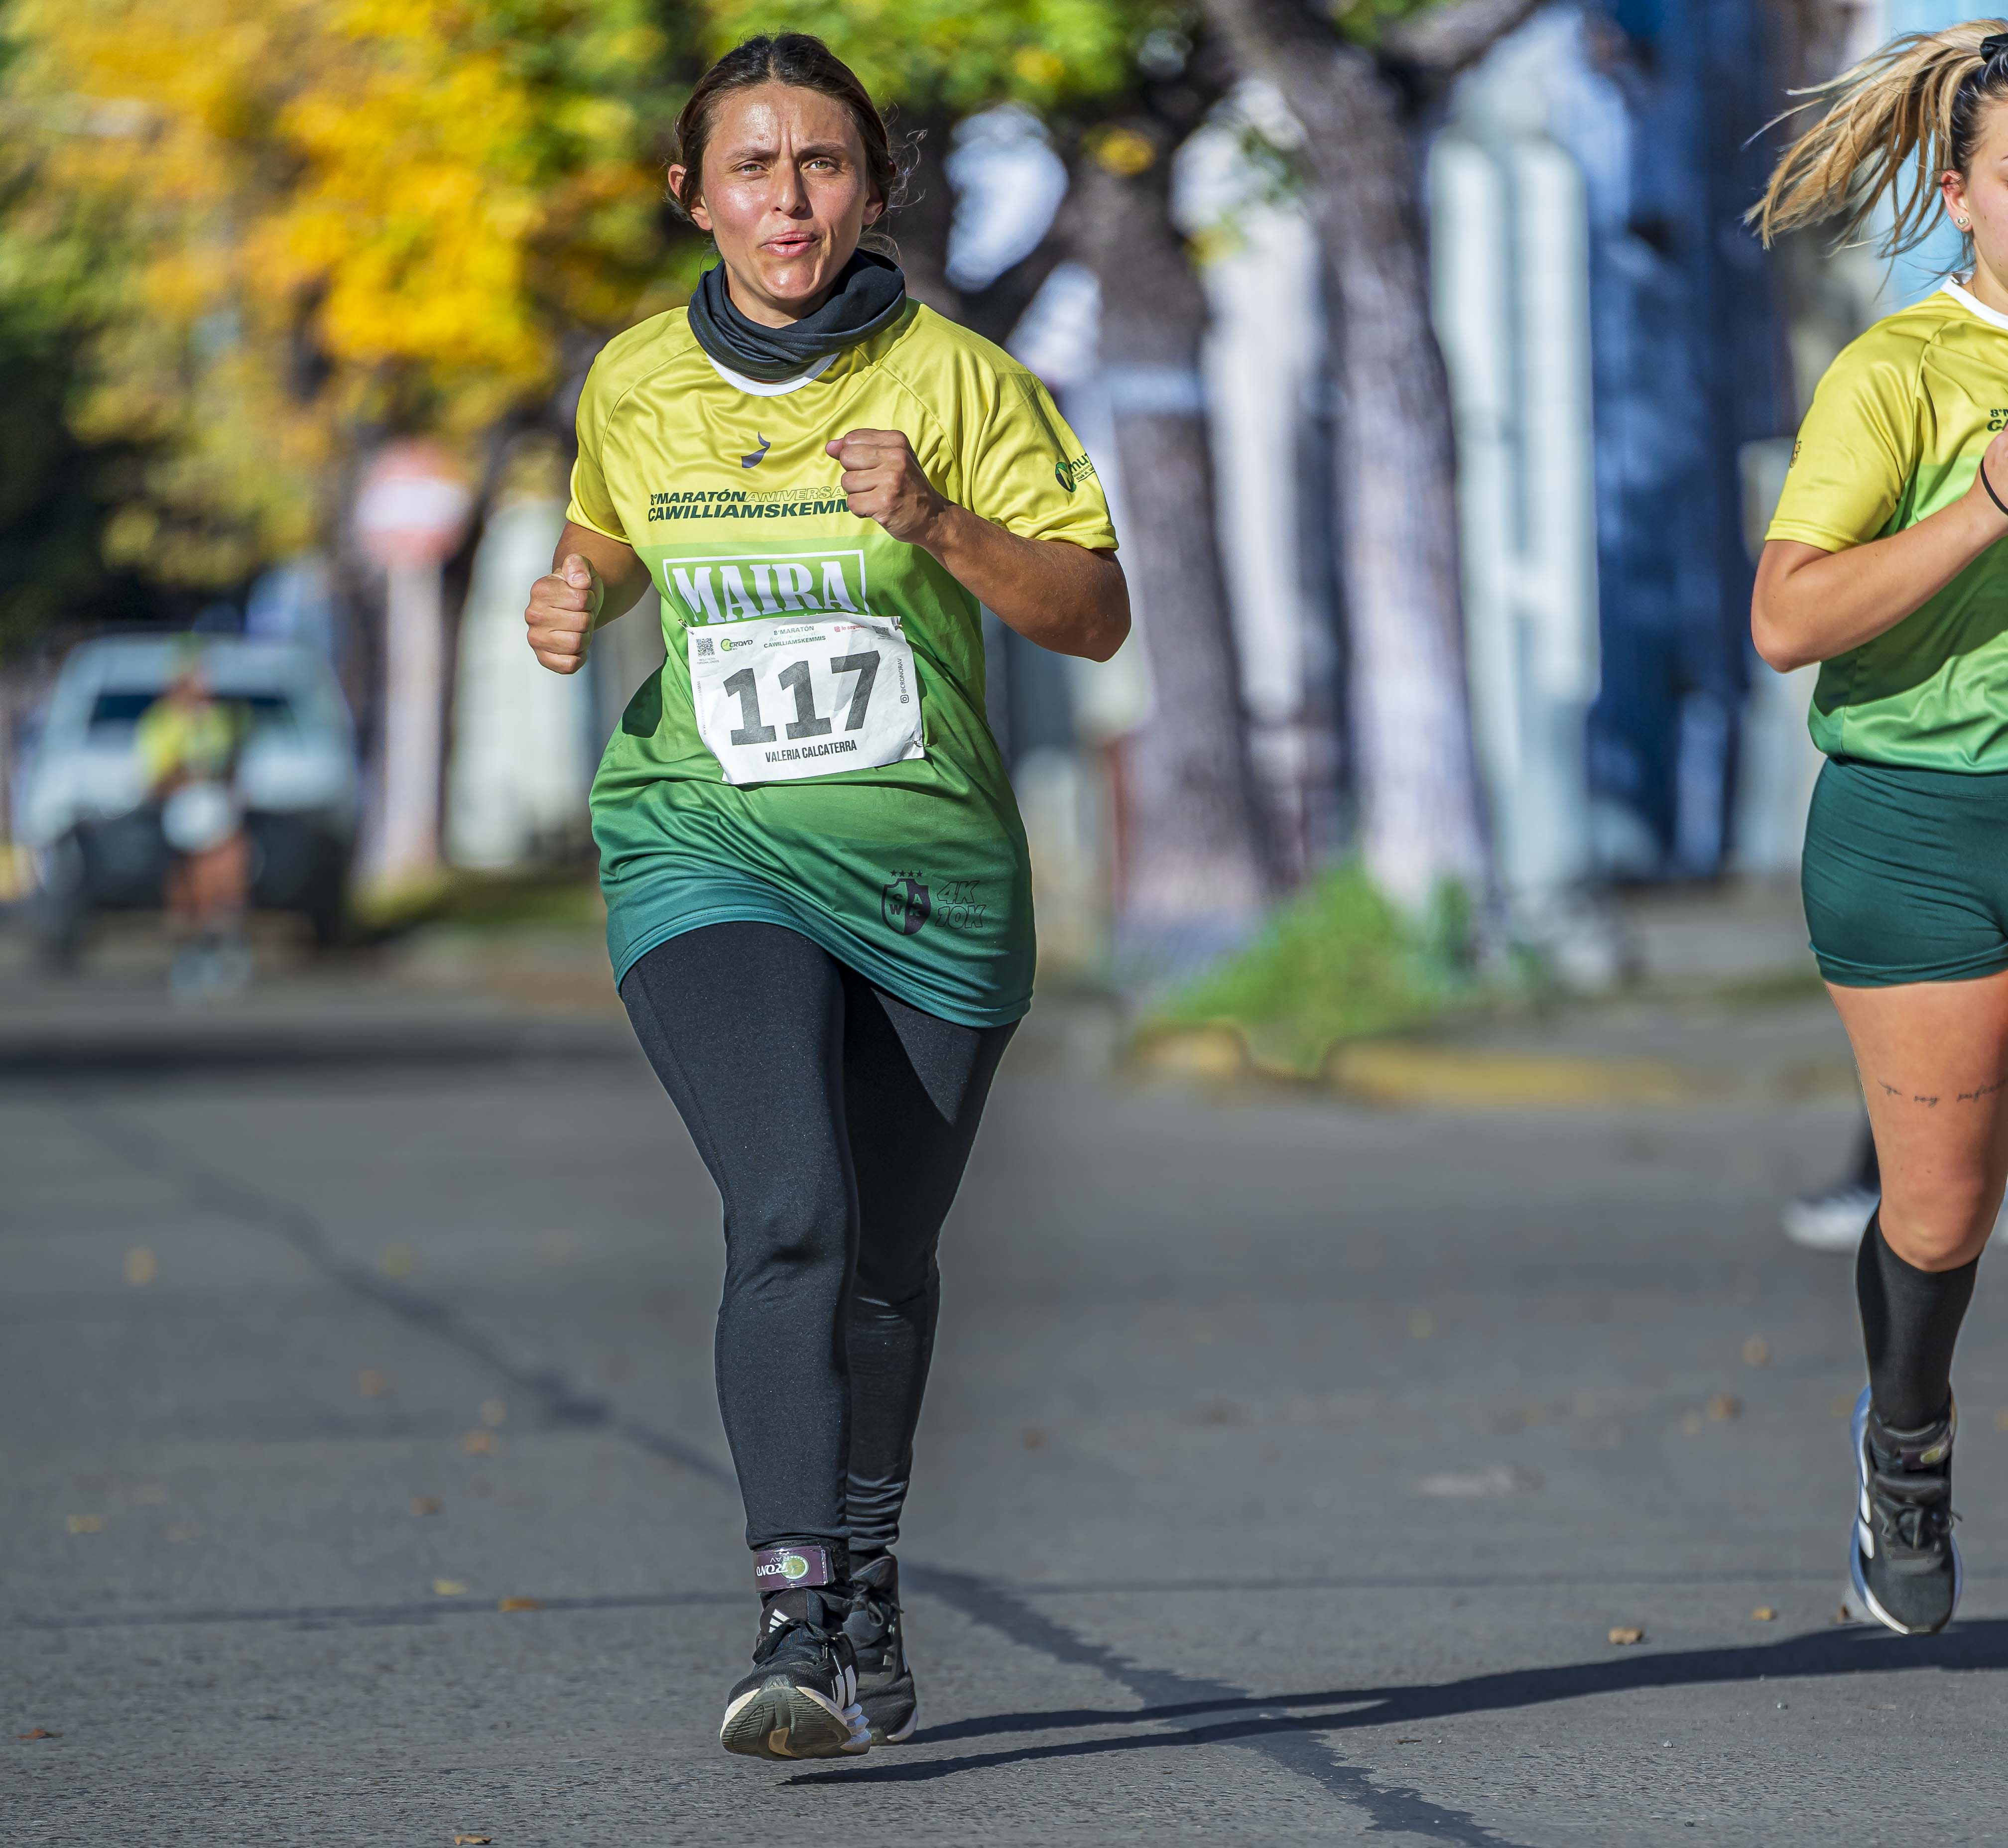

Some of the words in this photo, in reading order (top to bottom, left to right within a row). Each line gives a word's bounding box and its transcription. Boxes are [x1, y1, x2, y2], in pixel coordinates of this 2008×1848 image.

[745, 486, 848, 502] ANIVERSA
[672, 561, 858, 624] MAIRA
[763, 635, 826, 648] CAWILLIAMSKEMMIS
[897, 658, 906, 694] @CRONORAV
[723, 650, 881, 746] 117
[765, 748, 801, 762] VALERIA
[802, 739, 858, 758] CALCATERRA
[937, 880, 980, 904] 4K
[935, 904, 987, 929] 10K
